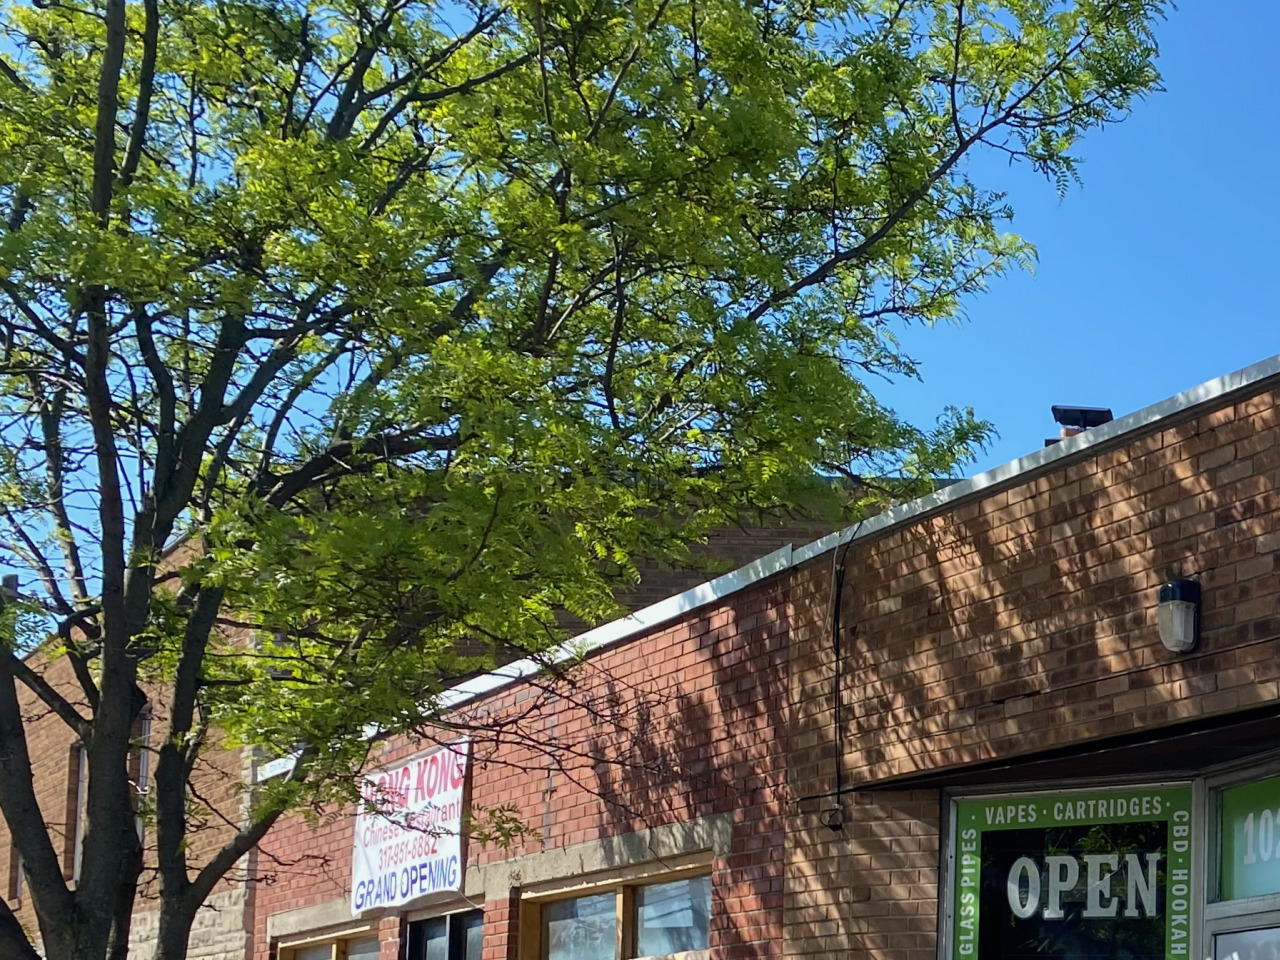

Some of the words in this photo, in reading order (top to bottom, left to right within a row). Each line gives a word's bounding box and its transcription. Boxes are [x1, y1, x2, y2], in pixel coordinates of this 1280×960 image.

[414, 743, 464, 803] KONG
[363, 822, 399, 848] Chinese
[985, 804, 1037, 825] VAPES
[1053, 796, 1162, 821] CARTRIDGES
[1173, 810, 1190, 853] CBD
[355, 871, 397, 910] GRAND
[400, 855, 457, 897] OPENING
[961, 828, 976, 887] PIPES
[1007, 853, 1161, 920] OPEN
[958, 892, 975, 955] GLASS
[1171, 868, 1189, 955] HOOKAH
